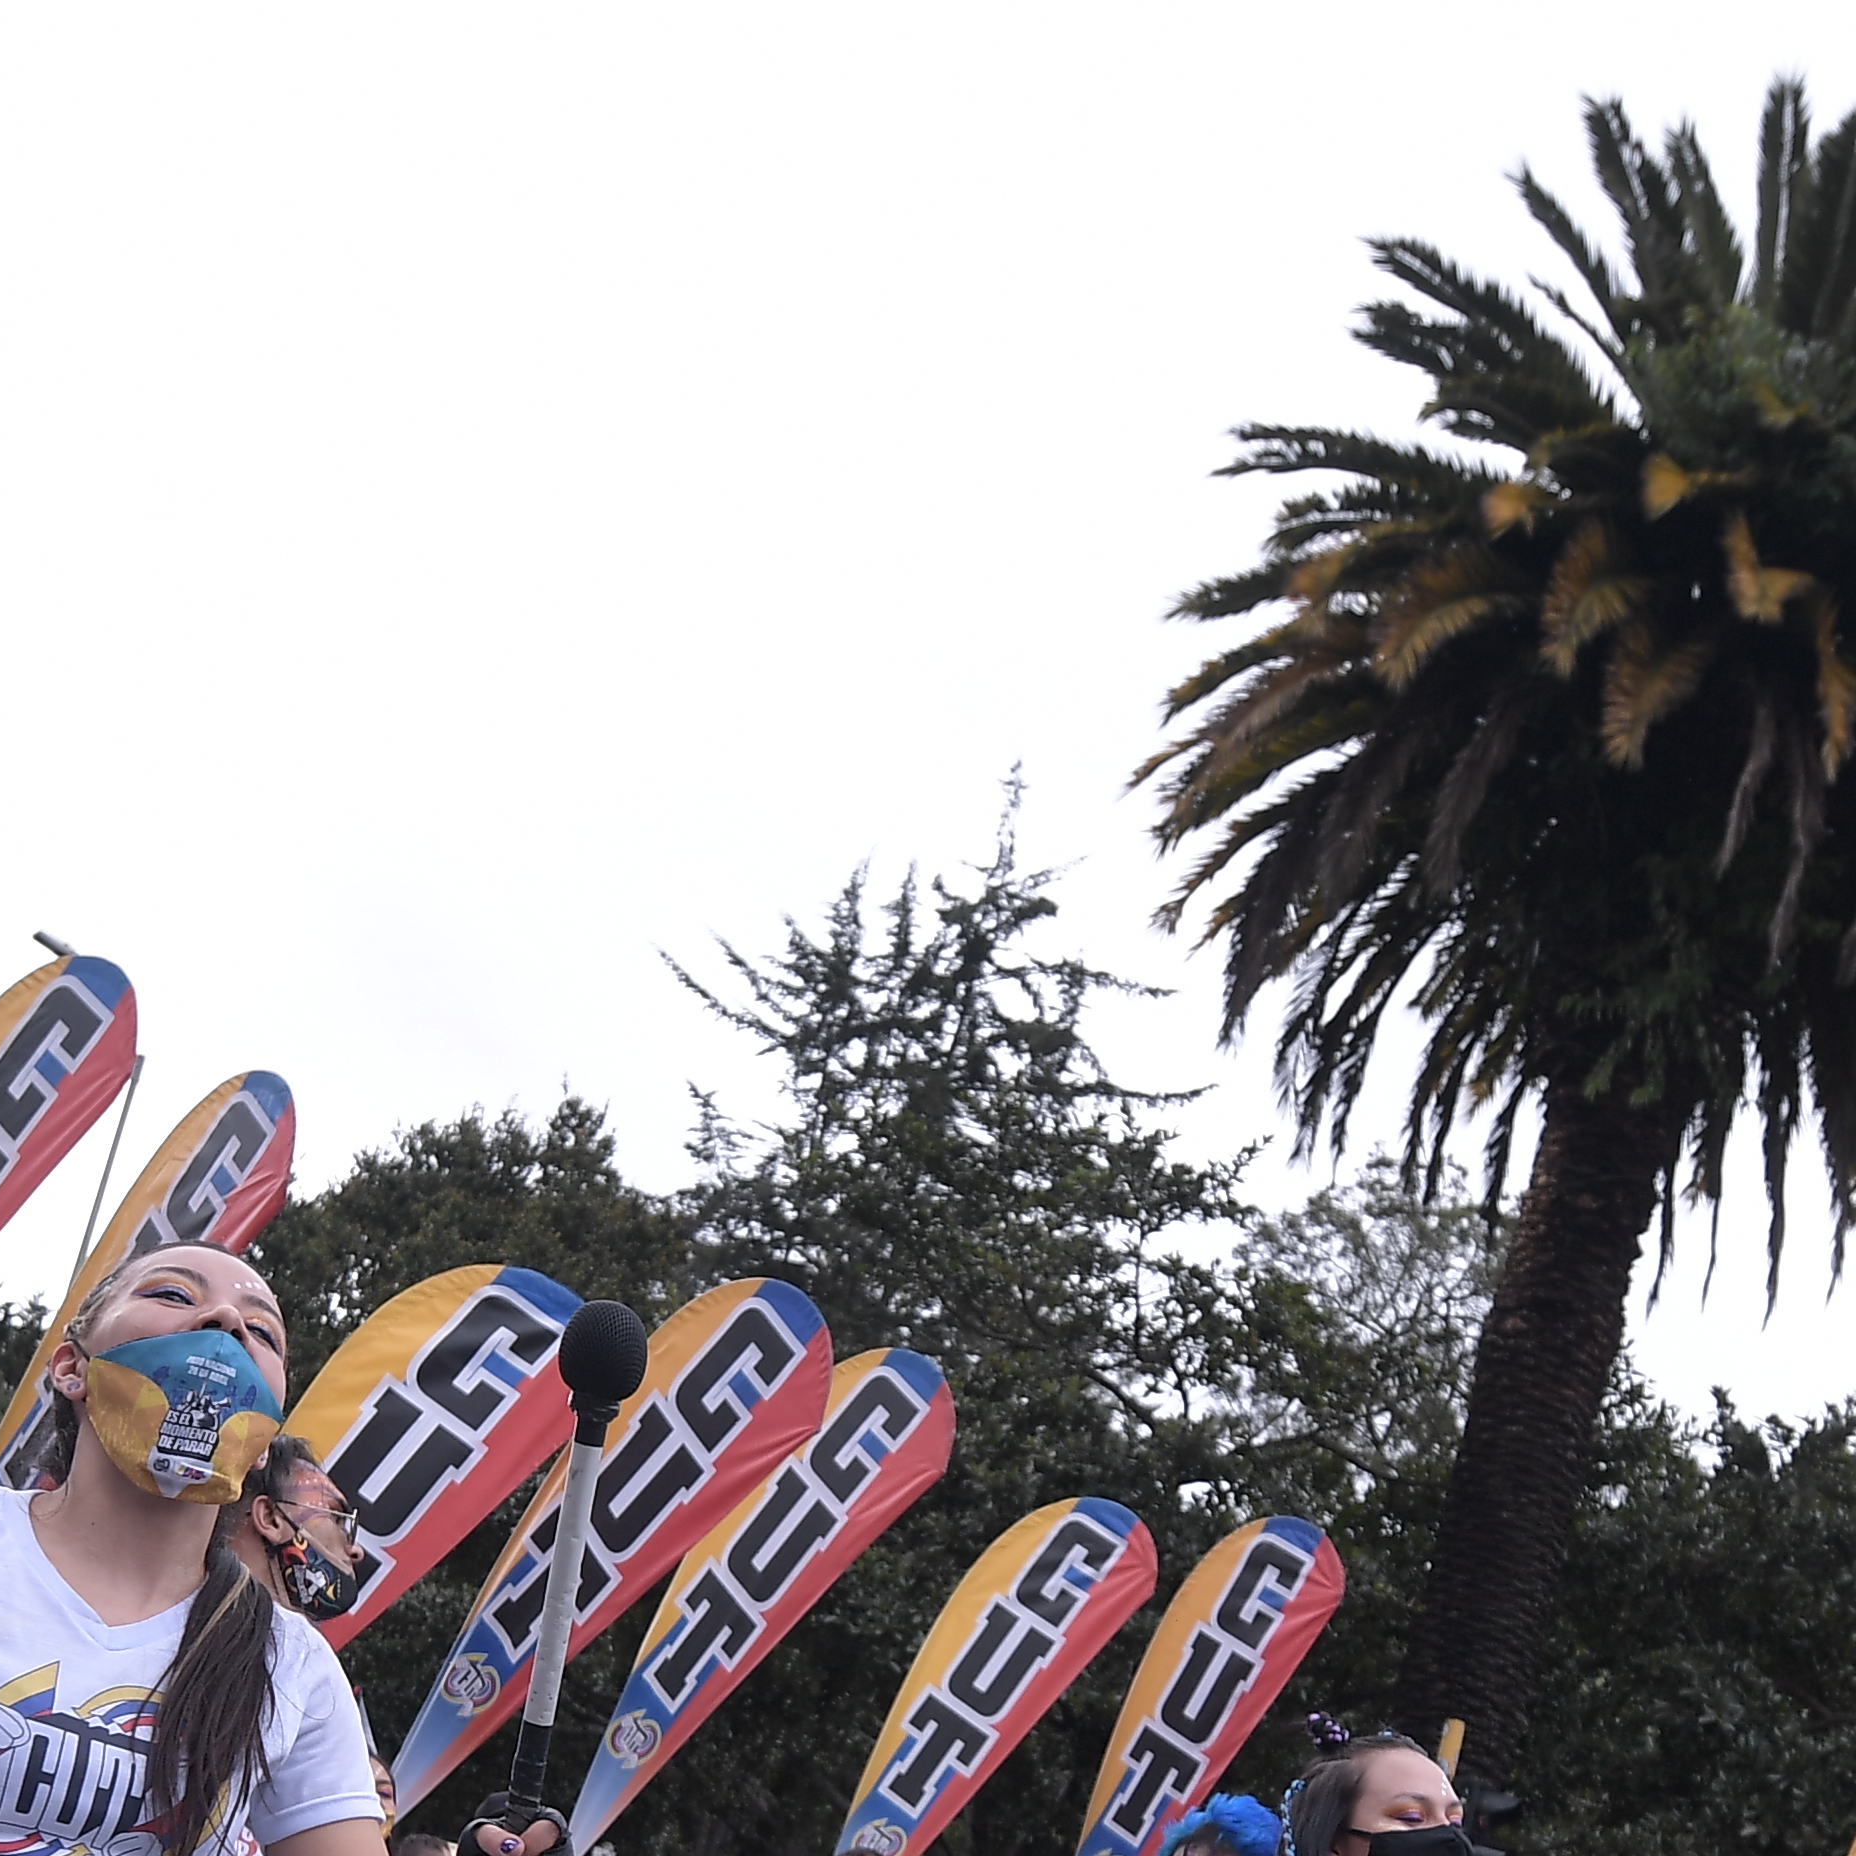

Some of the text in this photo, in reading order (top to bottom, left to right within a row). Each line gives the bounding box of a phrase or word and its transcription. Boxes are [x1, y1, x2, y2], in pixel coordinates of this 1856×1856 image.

[158, 1436, 213, 1457] DE PARAR
[160, 1421, 218, 1443] MOMENTO
[166, 1411, 191, 1425] ES EL
[326, 1290, 566, 1613] CU
[486, 1303, 802, 1660] CUT
[648, 1374, 927, 1706] CUT
[886, 1516, 1123, 1818] CUT
[1108, 1536, 1312, 1843] CUT
